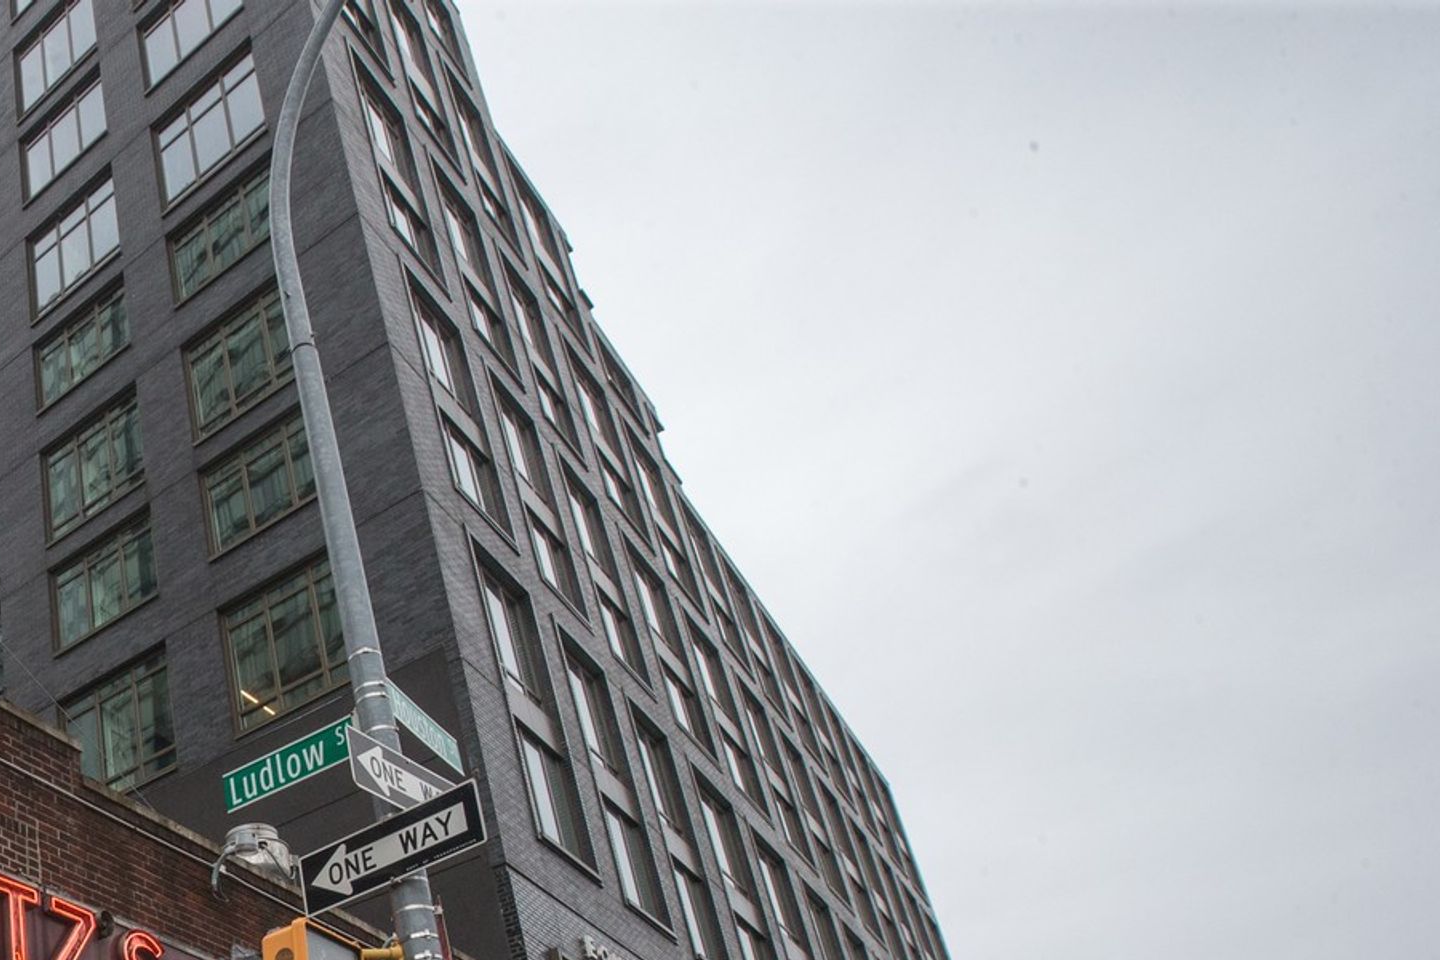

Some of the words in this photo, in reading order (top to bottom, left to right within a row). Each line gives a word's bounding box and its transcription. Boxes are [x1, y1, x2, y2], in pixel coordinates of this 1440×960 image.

[228, 739, 325, 807] Ludlow
[369, 756, 407, 792] ONE
[329, 847, 377, 885] ONE
[398, 810, 453, 855] WAY
